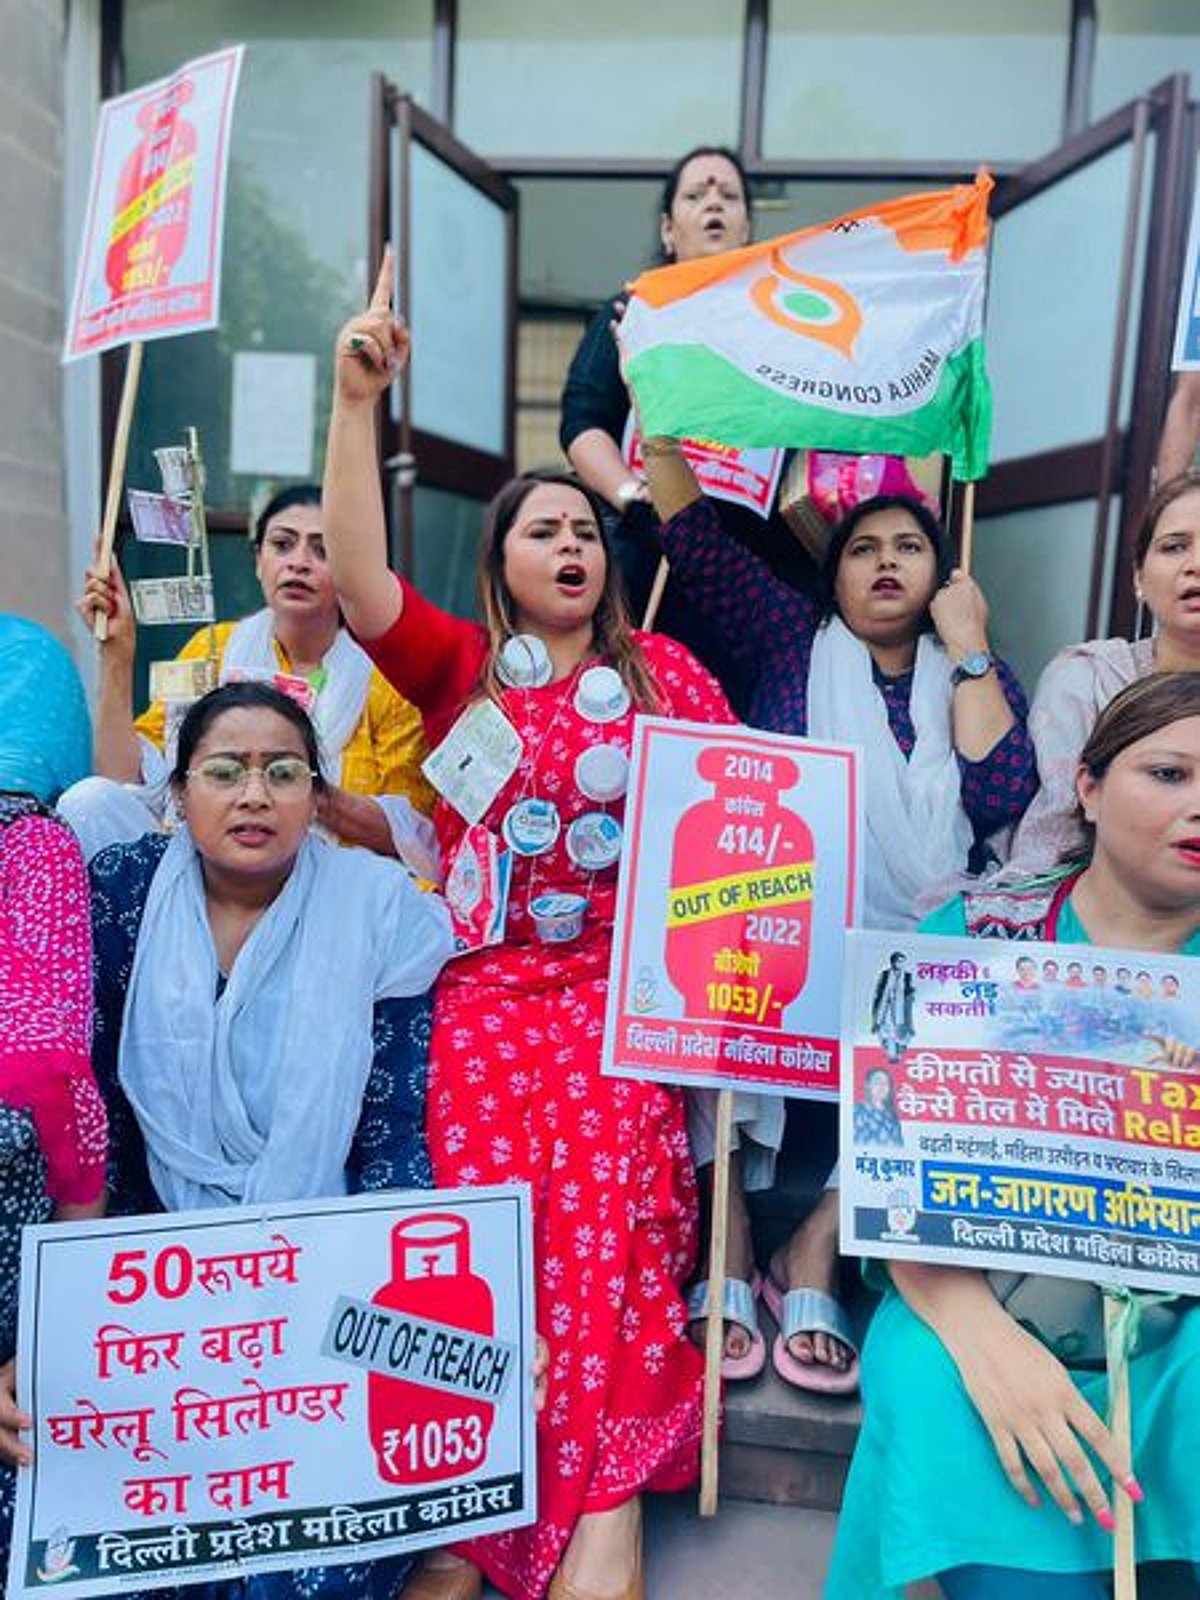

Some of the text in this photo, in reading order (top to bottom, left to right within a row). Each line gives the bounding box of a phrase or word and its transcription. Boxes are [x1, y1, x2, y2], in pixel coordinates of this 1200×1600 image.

[724, 754, 774, 783] 2014
[717, 822, 794, 865] 414/-
[673, 871, 813, 918] OUT OF REACH
[745, 914, 802, 946] 2022
[706, 983, 782, 1022] 1053/-
[626, 1023, 678, 1053] दिल्ली
[681, 1029, 721, 1058] प्रदेश
[724, 1034, 777, 1064] महिला
[905, 1052, 1001, 1085] कीमतों
[1008, 1054, 1037, 1088] से
[1044, 1066, 1125, 1100] ज्यादा
[896, 1082, 957, 1118] कैसे
[963, 1087, 1017, 1122] तेल
[1024, 1092, 1049, 1127] में
[1056, 1096, 1115, 1135] मिले
[1004, 1138, 1043, 1162] महिला
[928, 1170, 1097, 1221] जन-जागरण
[952, 1218, 1199, 1271] दिल्ली प्रदेश महिला कांग्रेस
[94, 1316, 288, 1379] फिर बढ़ा
[334, 1306, 511, 1395] OUT OF REACH
[46, 1378, 349, 1462] घरेलू सिलेण्डर
[382, 1414, 483, 1476] ₹1053
[122, 1459, 295, 1516] का दाम
[96, 1524, 200, 1570] दिल्ली
[208, 1515, 292, 1558] प्रदेश
[301, 1502, 410, 1543] महिला
[417, 1482, 514, 1526] कांग्रेस
